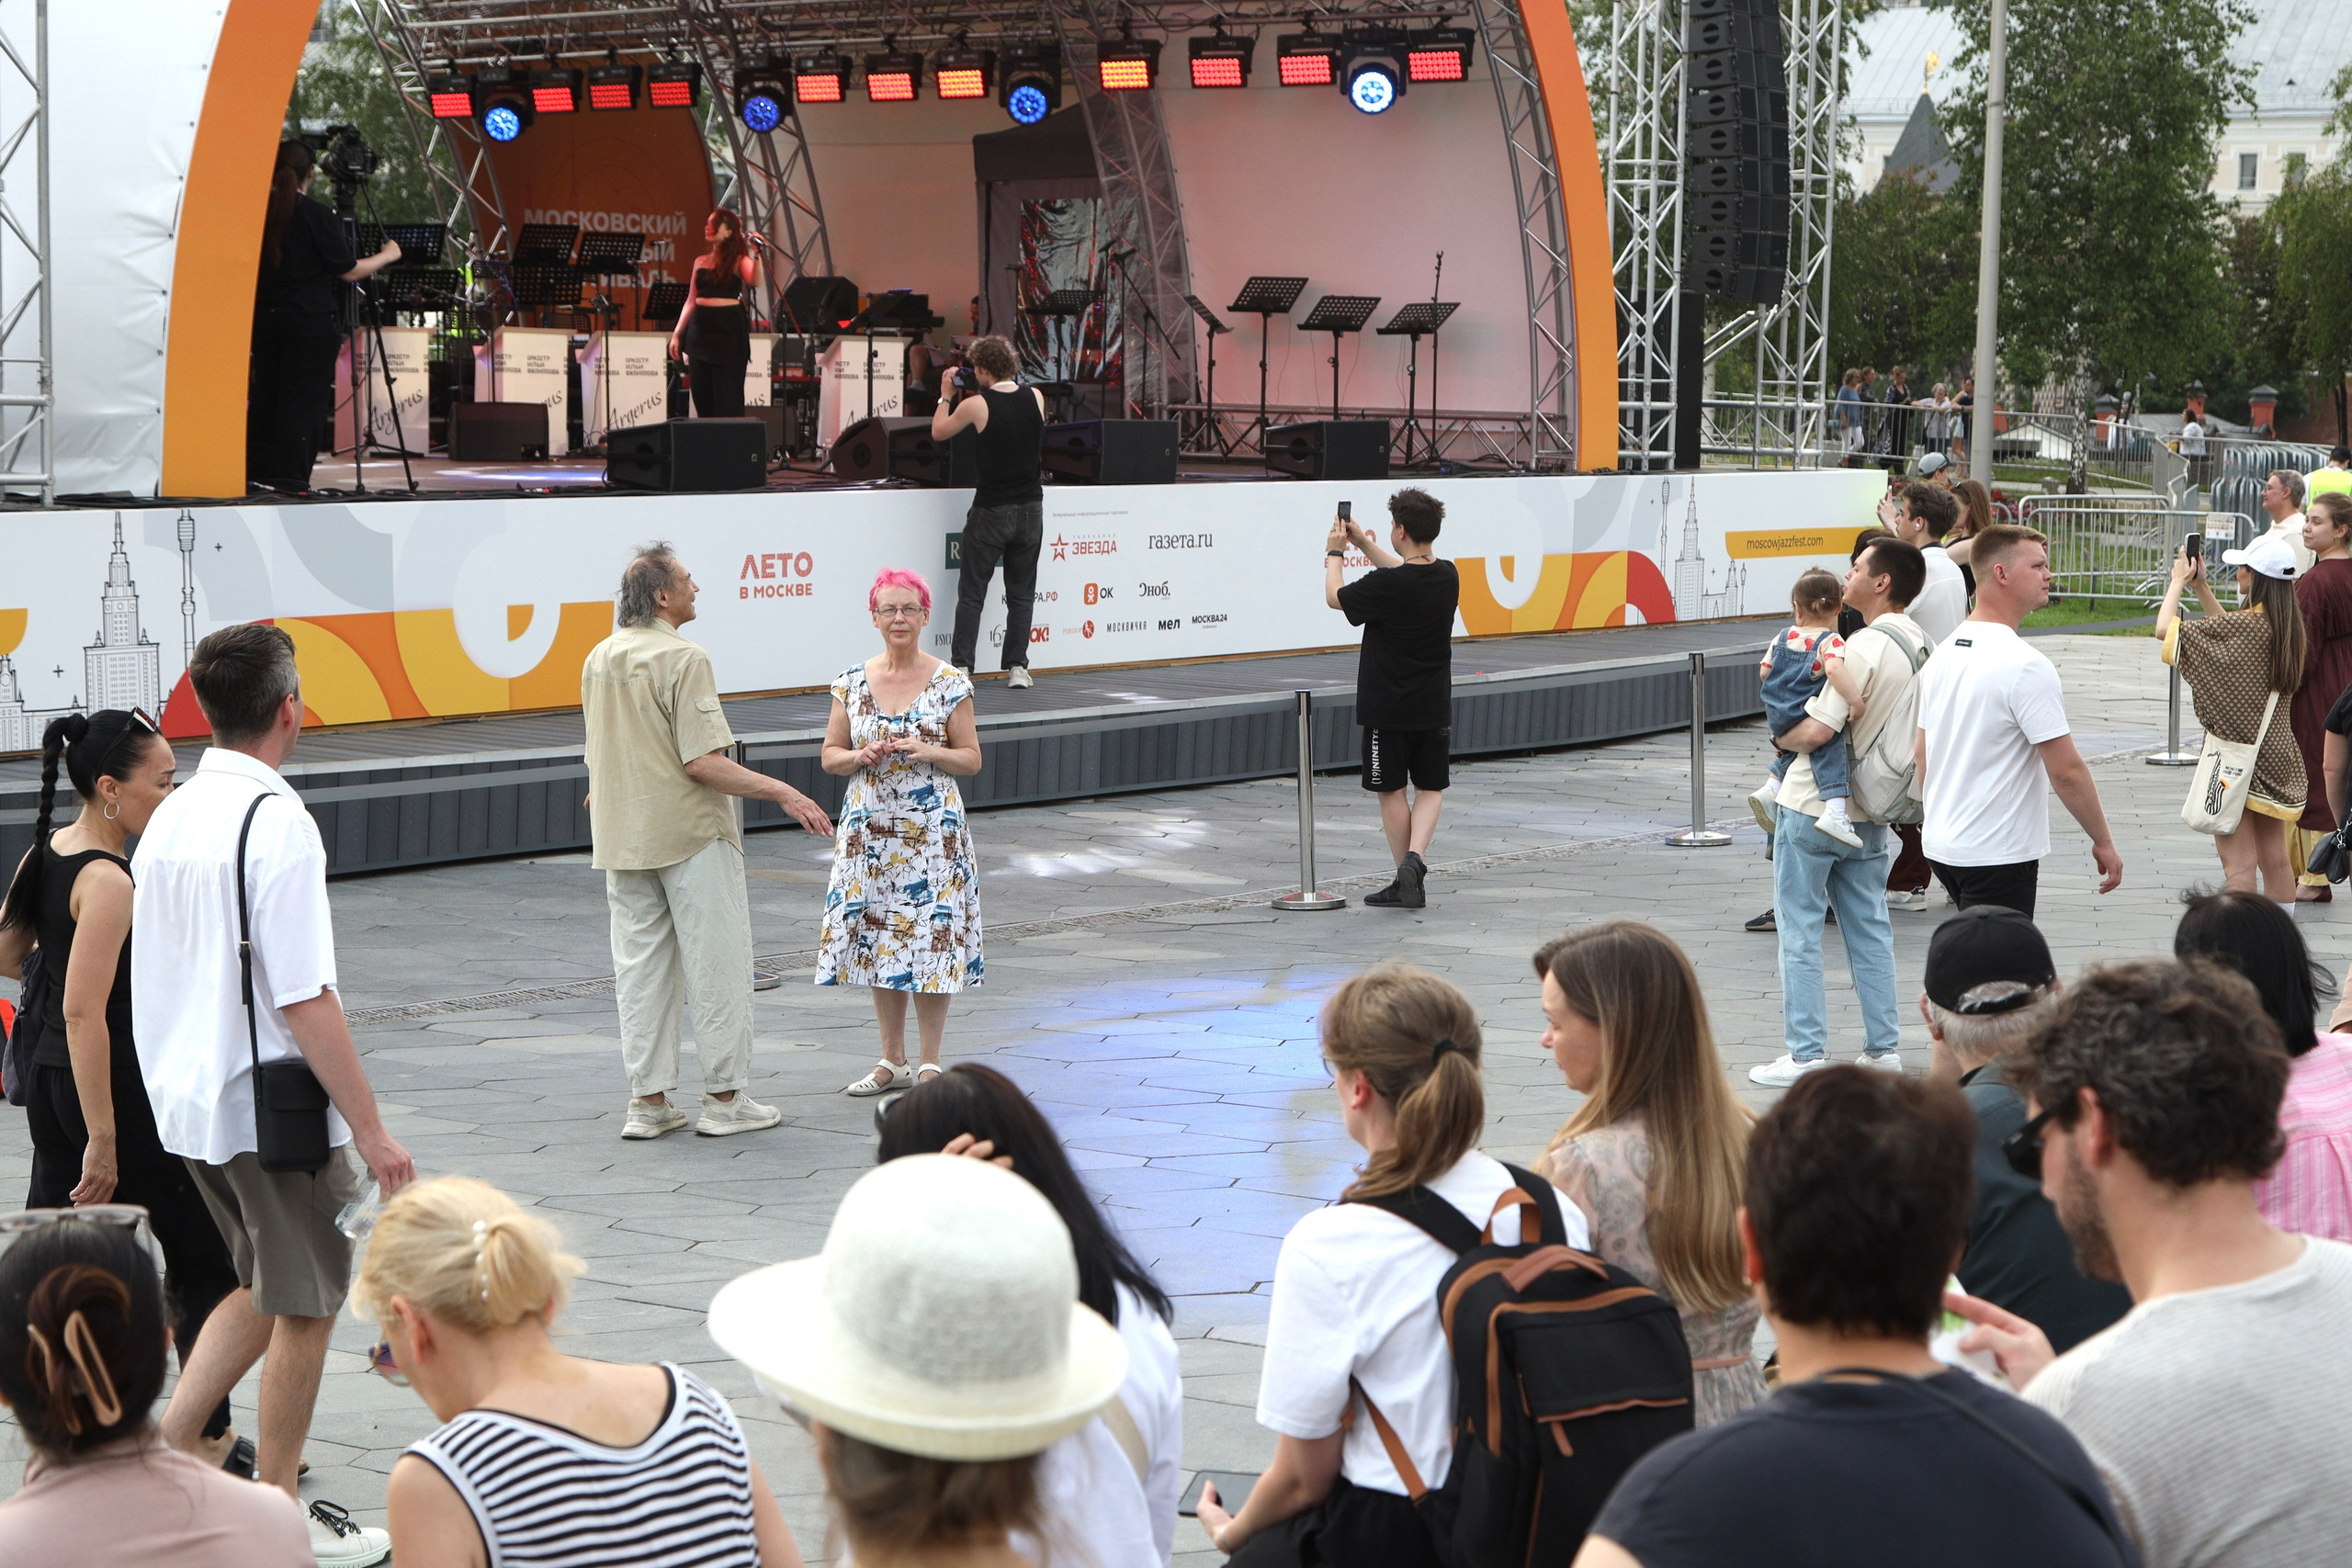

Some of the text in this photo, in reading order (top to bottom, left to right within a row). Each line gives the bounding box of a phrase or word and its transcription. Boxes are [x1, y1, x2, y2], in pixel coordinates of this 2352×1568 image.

[524, 208, 687, 235] МОСКОВСКИЙ
[1072, 540, 1117, 556] ЗВЕЗДА
[1148, 534, 1214, 549] газета.ru
[1747, 536, 1824, 550] moscowjazzfest.com
[740, 551, 813, 580] ЛЕТО
[740, 582, 813, 599] В МОСКВЕ
[1106, 620, 1148, 633] МОСКВИЧКА
[1158, 618, 1181, 631] мел
[1029, 626, 1050, 643] OK!
